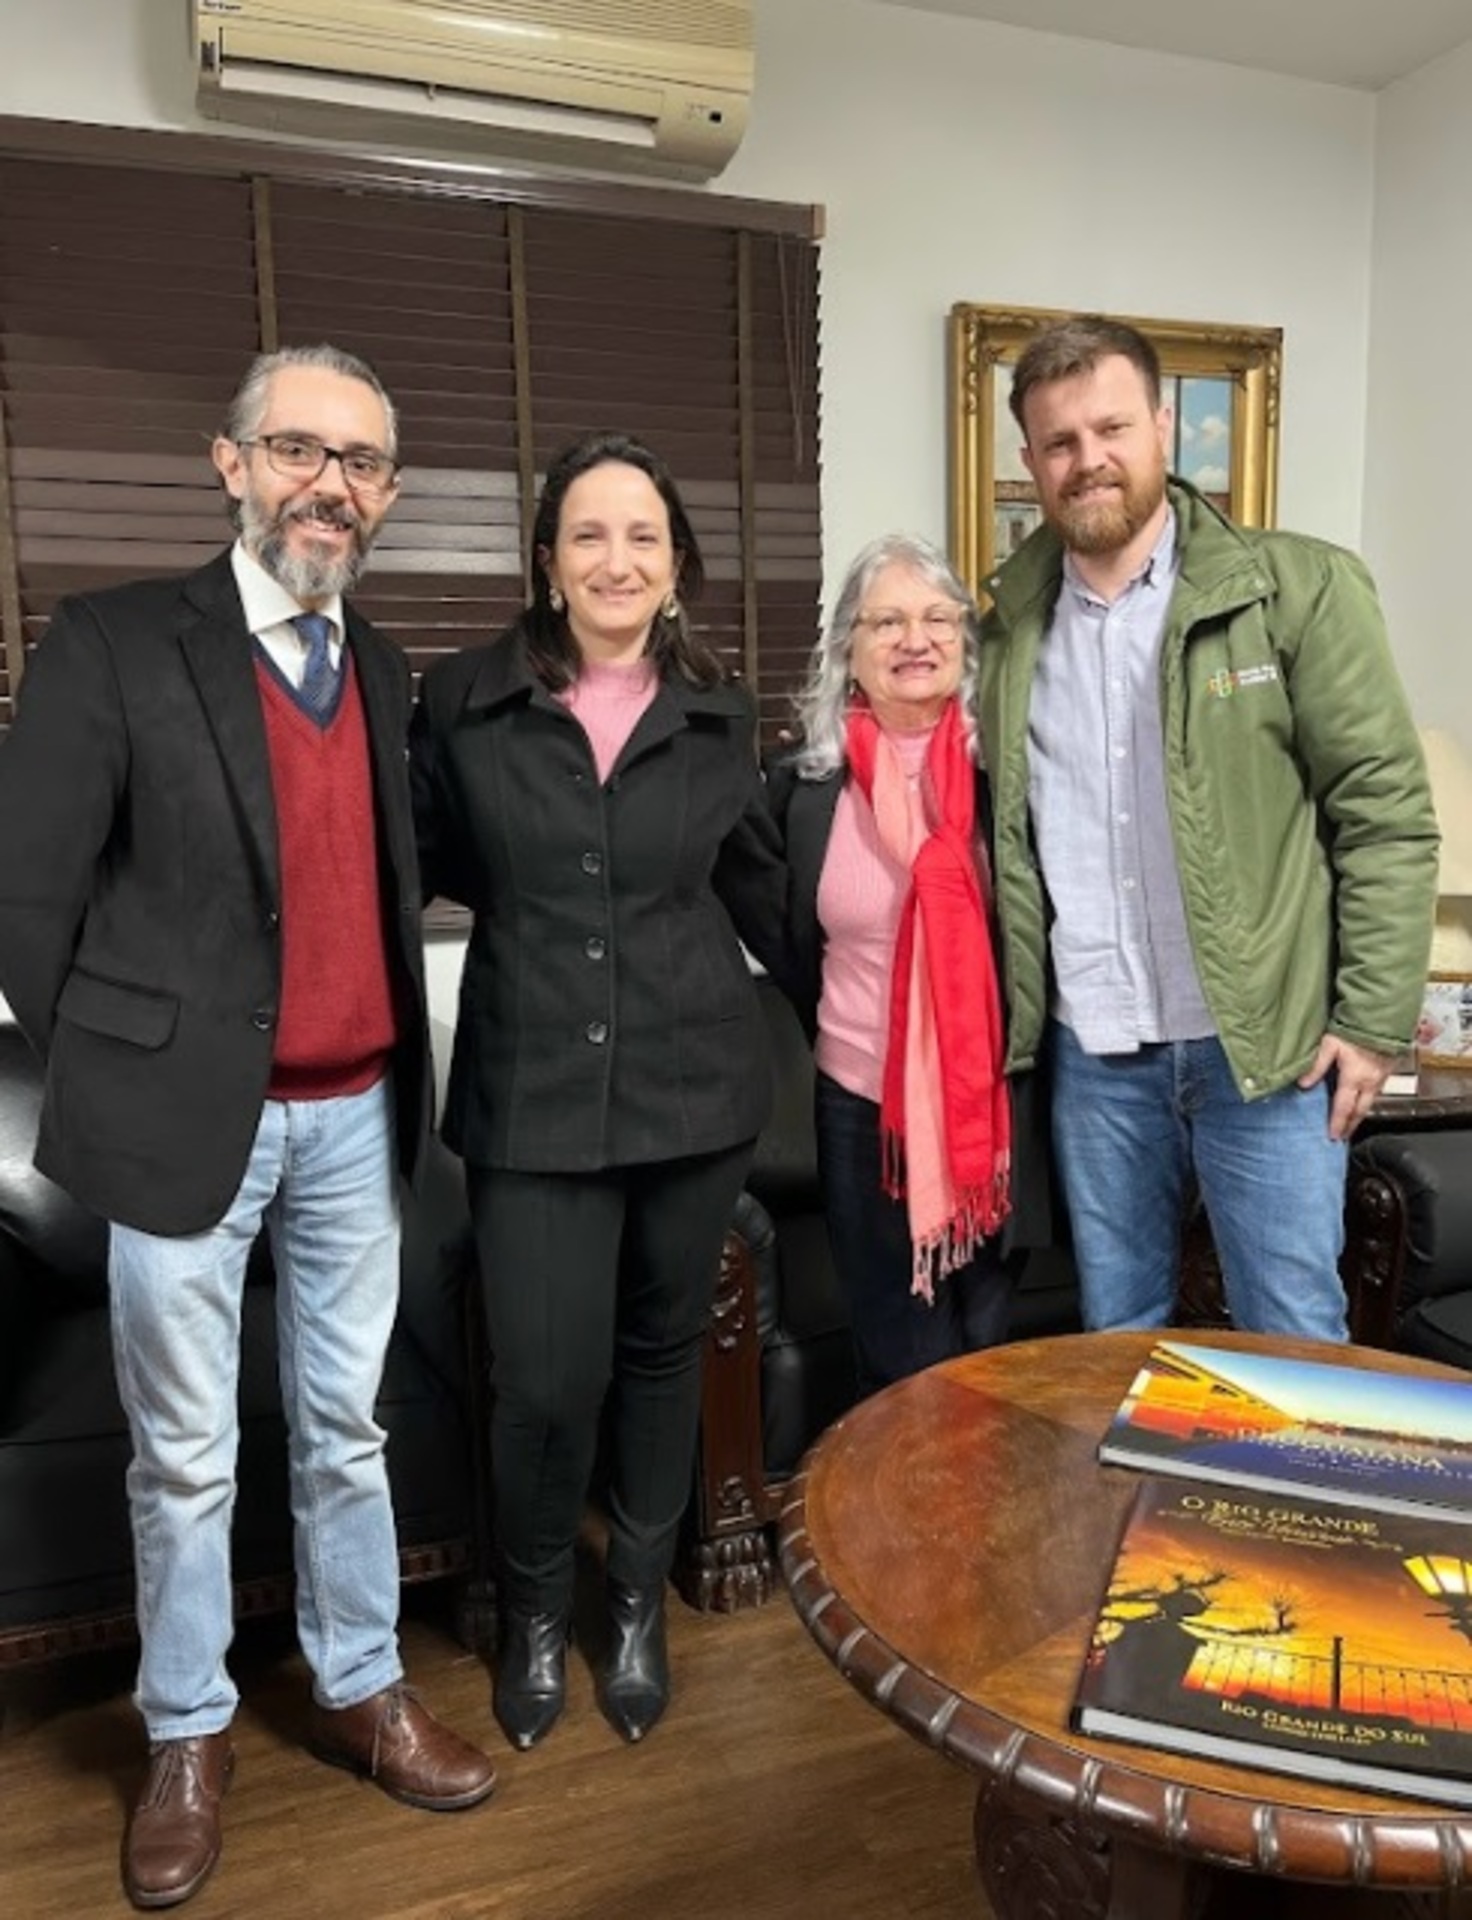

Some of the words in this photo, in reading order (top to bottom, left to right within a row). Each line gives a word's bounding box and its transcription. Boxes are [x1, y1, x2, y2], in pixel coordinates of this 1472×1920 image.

[1181, 1495, 1205, 1510] O
[1212, 1499, 1260, 1521] RIO
[1266, 1507, 1379, 1537] GRANDE
[1221, 1699, 1258, 1719] RIO
[1262, 1709, 1349, 1735] GRANDE
[1353, 1724, 1386, 1741] DO
[1390, 1729, 1429, 1746] SUL
